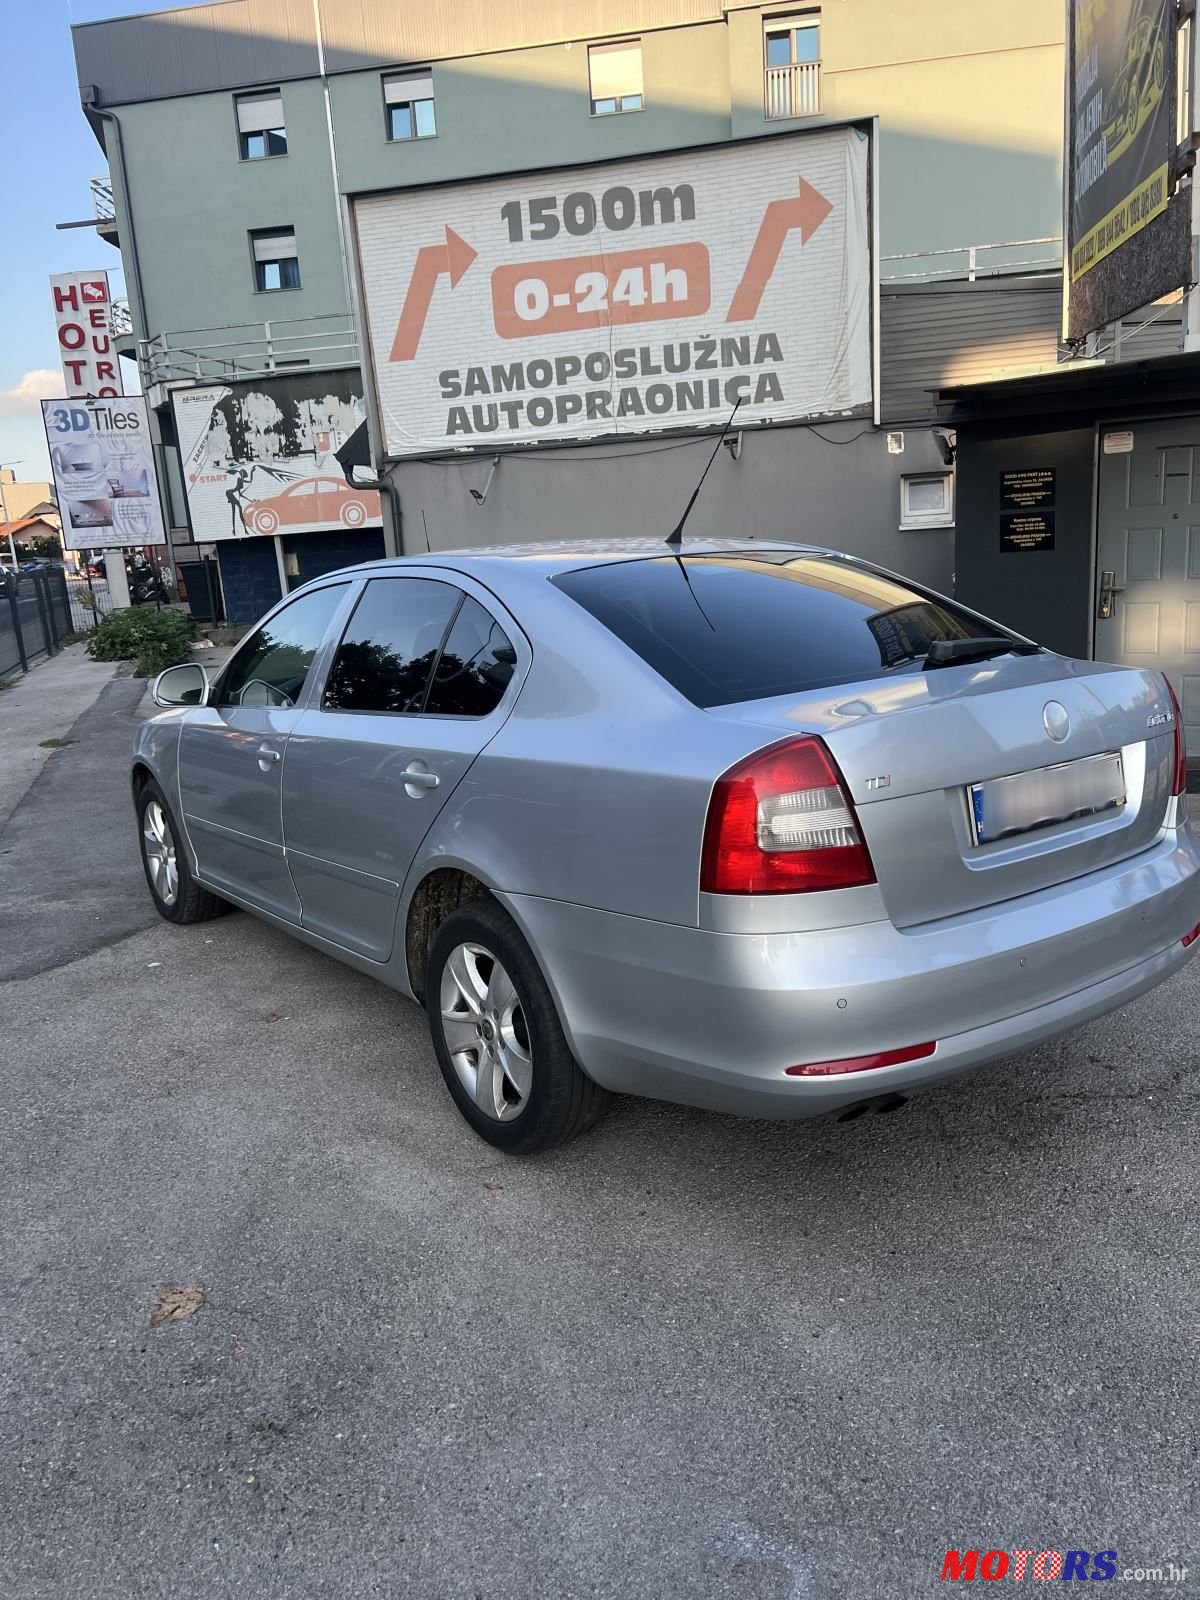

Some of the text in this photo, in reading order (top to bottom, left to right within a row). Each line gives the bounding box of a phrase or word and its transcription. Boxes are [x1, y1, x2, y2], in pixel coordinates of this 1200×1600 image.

[500, 183, 696, 243] 1500m
[513, 262, 688, 321] 0-24h
[53, 285, 87, 399] HOT
[439, 332, 784, 399] SAMOPOSLUŽNA
[446, 372, 784, 435] AUTOPRAONICA
[200, 474, 228, 483] START
